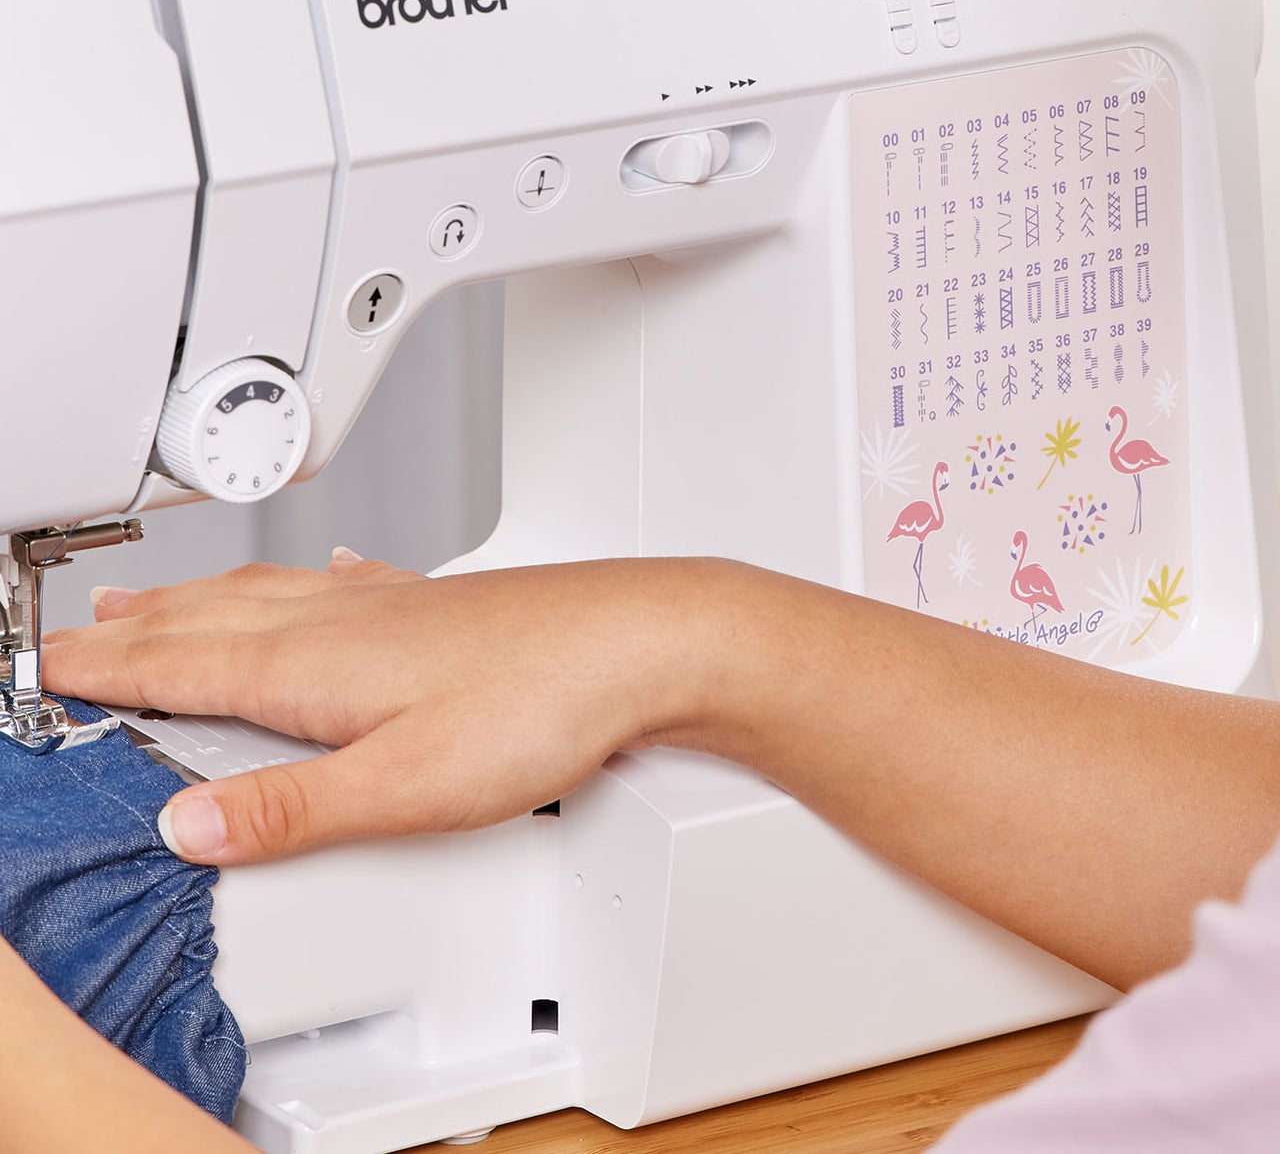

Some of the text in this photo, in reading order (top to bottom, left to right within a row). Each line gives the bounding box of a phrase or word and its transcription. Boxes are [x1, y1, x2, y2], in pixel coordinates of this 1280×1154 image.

[882, 90, 1146, 148] 00 01 02 03 04 05 06 07 08 09
[885, 166, 1148, 225] 10 11 12 13 14 15 16 17 18 19
[887, 242, 1150, 303] 20 21 22 23 24 25 26 27 28 29
[890, 318, 1152, 380] 30 31 32 33 34 35 36 37 38 39
[221, 399, 233, 412] 5
[246, 385, 255, 398] 4
[270, 388, 280, 401] 3
[1036, 612, 1082, 645] Angel
